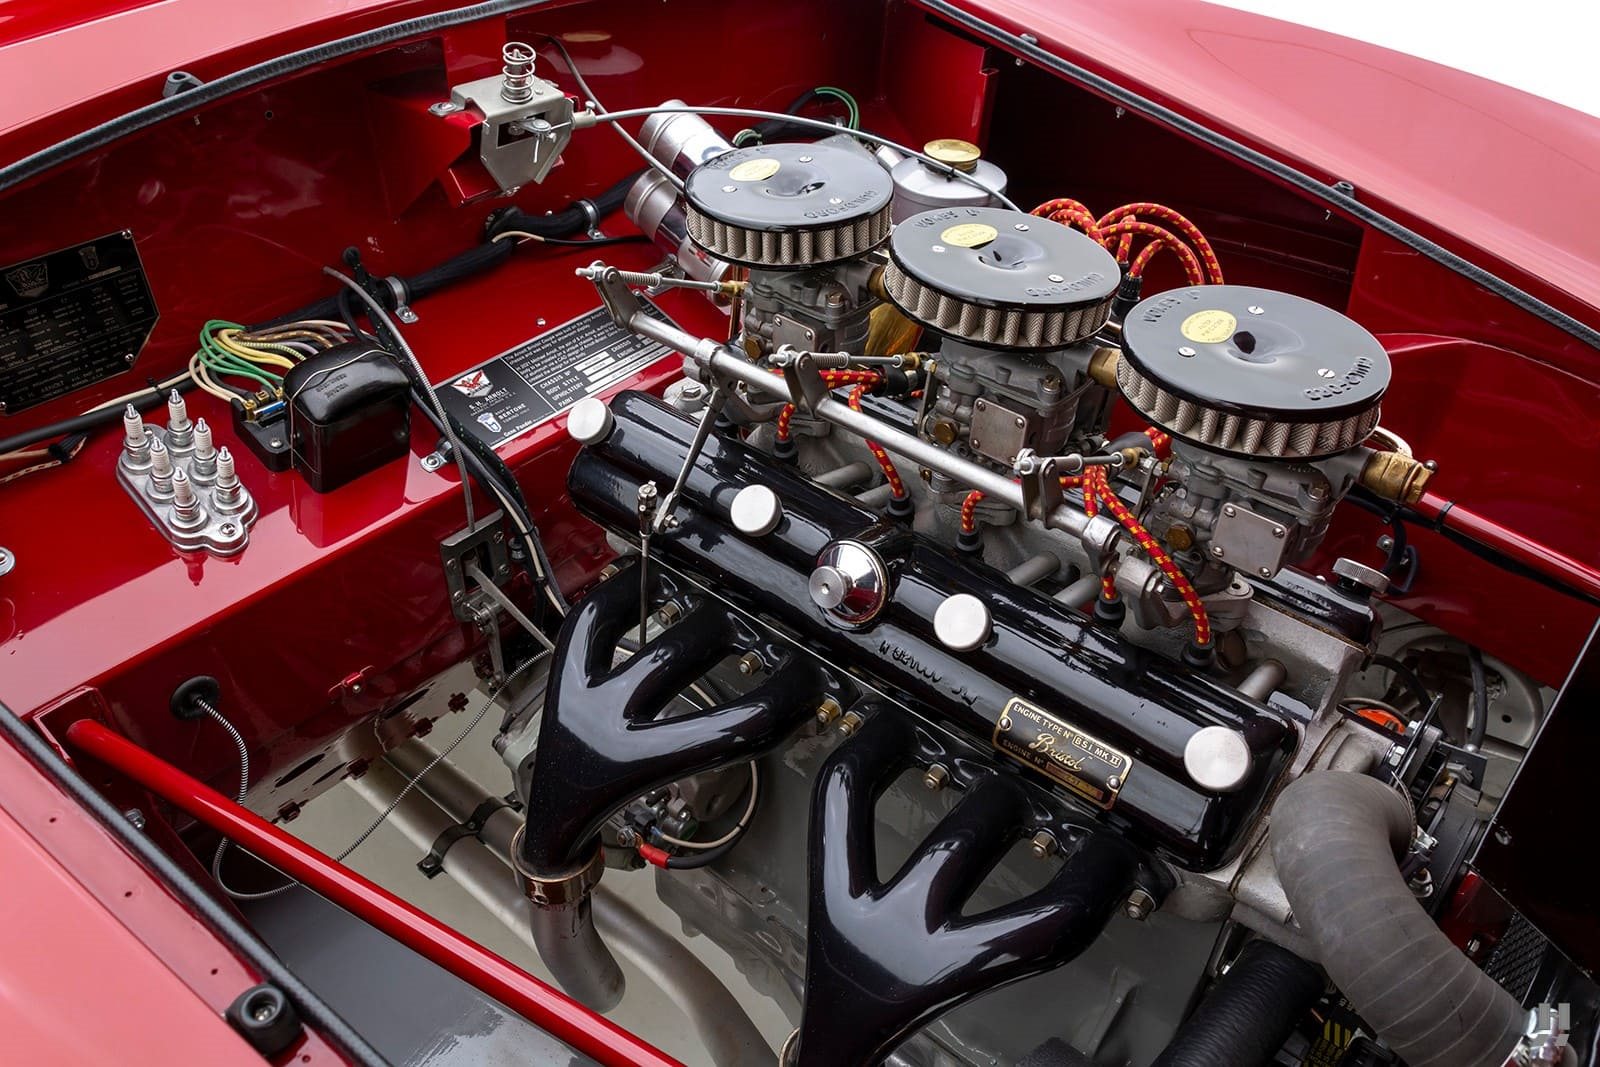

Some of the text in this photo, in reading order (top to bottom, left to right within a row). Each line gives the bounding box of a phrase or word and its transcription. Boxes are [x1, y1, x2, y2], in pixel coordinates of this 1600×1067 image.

[1002, 739, 1034, 762] ENGINE
[1013, 704, 1042, 723] ENGINE
[1042, 717, 1063, 735] TYPE
[1095, 747, 1110, 761] MK
[1029, 733, 1083, 772] Bristol
